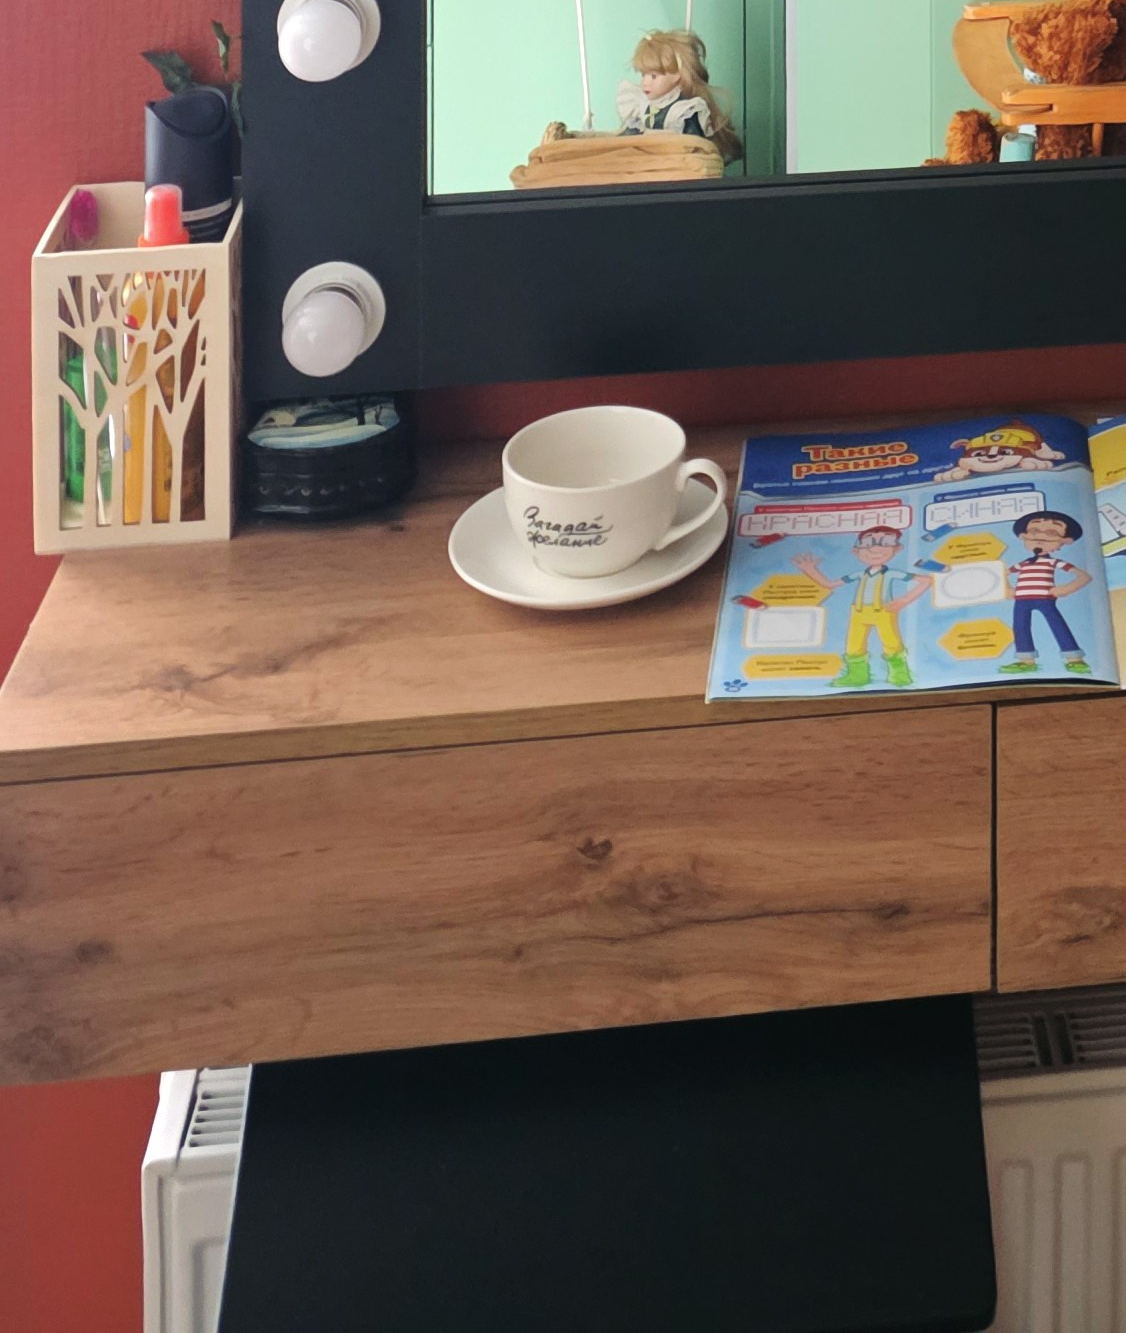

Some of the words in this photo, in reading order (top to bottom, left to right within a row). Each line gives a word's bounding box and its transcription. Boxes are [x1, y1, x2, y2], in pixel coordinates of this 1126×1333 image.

[803, 441, 908, 461] Такие
[793, 452, 919, 478] разные
[523, 506, 613, 535] Загадай
